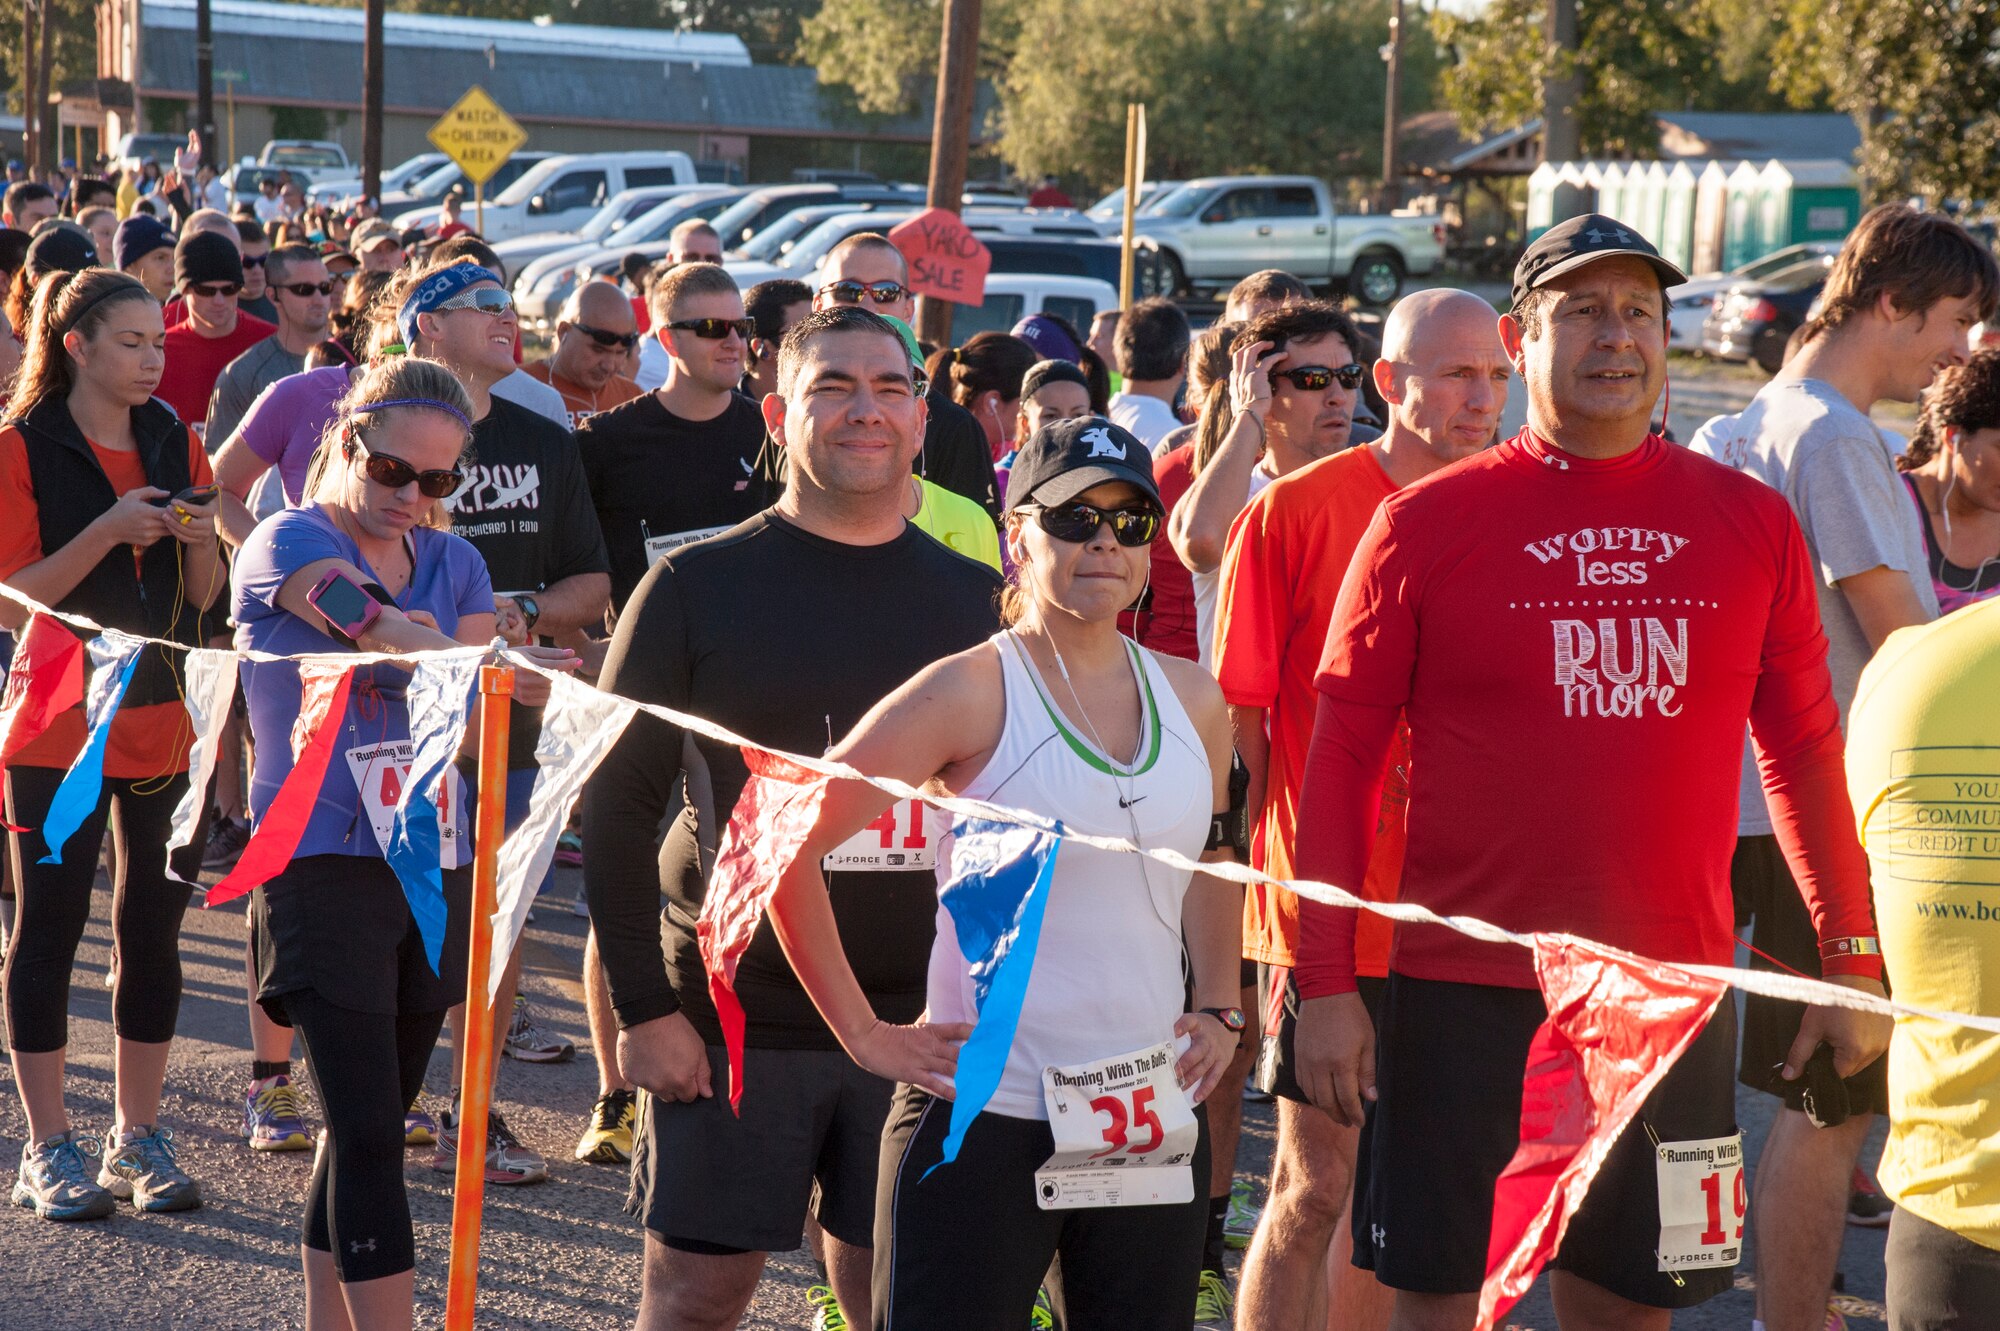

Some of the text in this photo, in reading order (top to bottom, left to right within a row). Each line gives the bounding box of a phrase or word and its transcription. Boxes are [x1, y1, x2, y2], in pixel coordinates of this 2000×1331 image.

[457, 109, 499, 122] WATCH
[451, 129, 508, 142] CHILDREN
[461, 149, 495, 162] AREA
[919, 221, 980, 259] YARD
[911, 258, 964, 291] SALE
[519, 520, 539, 533] 2010
[652, 538, 683, 550] Running
[683, 533, 701, 545] With
[1523, 527, 1690, 564] worry
[1574, 553, 1648, 586] less
[1550, 617, 1689, 686] RUN
[1563, 683, 1683, 718] more
[355, 747, 396, 762] Running
[380, 765, 449, 823] 44
[1954, 782, 2000, 798] YOU
[1916, 808, 2000, 825] COMMU
[1907, 835, 1977, 853] CREDIT
[1054, 1051, 1167, 1087] Running With The Bulls
[1104, 1081, 1135, 1093] November
[1087, 1085, 1165, 1160] 35
[1667, 1143, 1738, 1163] Running With
[1680, 1253, 1714, 1262] FORCE
